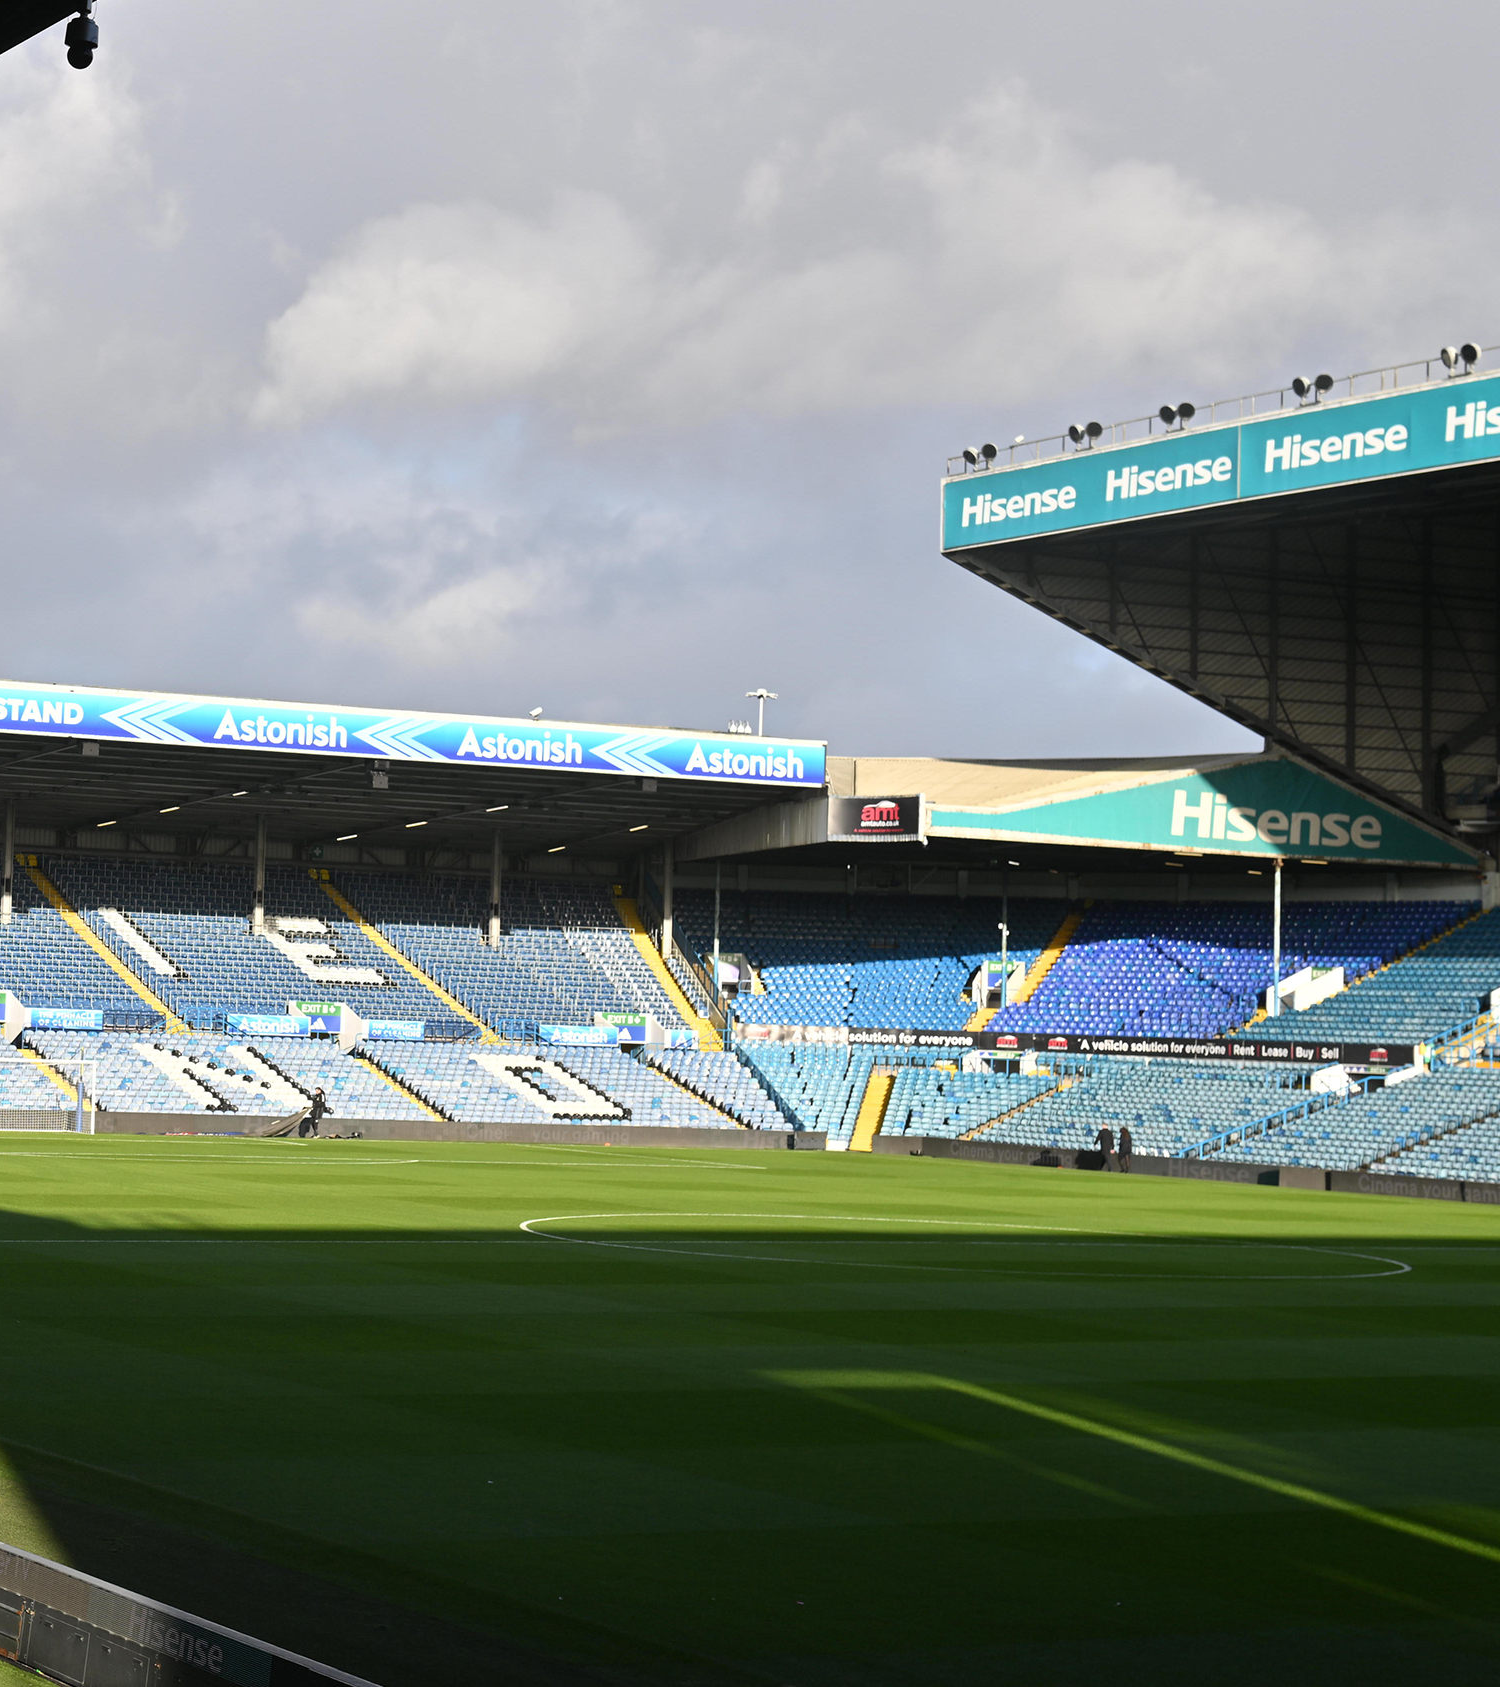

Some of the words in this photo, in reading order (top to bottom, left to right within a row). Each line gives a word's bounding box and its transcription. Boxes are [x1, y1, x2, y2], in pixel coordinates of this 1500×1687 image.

[1445, 400, 1500, 442] His
[1265, 424, 1408, 473] Hisense
[1105, 455, 1232, 501] Hisense
[962, 485, 1077, 527] Hisense
[214, 708, 348, 748] Astonish
[456, 726, 583, 765] Astonish
[685, 742, 804, 779] Astonish
[861, 803, 900, 821] amt
[1171, 789, 1382, 849] Hisense
[38, 1010, 54, 1019] THE
[56, 1011, 96, 1020] PINNACLE
[301, 1004, 322, 1013] EXIT
[607, 1015, 626, 1024] EXIT
[38, 1018, 50, 1026] OF
[51, 1019, 95, 1027] CLEANING
[239, 1017, 300, 1034] Astonish
[372, 1022, 385, 1030] THE
[551, 1028, 608, 1044] Astonish
[848, 1031, 896, 1044] solution
[899, 1032, 916, 1045] for
[919, 1035, 973, 1048] everyone
[1093, 1040, 1129, 1052] vehicle
[1131, 1041, 1169, 1053] solution
[1171, 1042, 1184, 1053] for
[1185, 1044, 1226, 1056] everyone
[1233, 1045, 1255, 1056] Rent
[1262, 1045, 1289, 1058] Lease
[1296, 1047, 1314, 1059] Buy
[1321, 1047, 1339, 1059] Sell
[532, 1128, 568, 1143] your
[572, 1128, 630, 1145] gaming
[950, 1141, 994, 1157] Cinema
[996, 1146, 1025, 1162] your
[1027, 1149, 1073, 1167] gaming
[1168, 1158, 1249, 1182] Hisense
[1358, 1174, 1418, 1195] Cinema
[1422, 1180, 1459, 1201] your
[130, 1602, 223, 1673] Hisense
